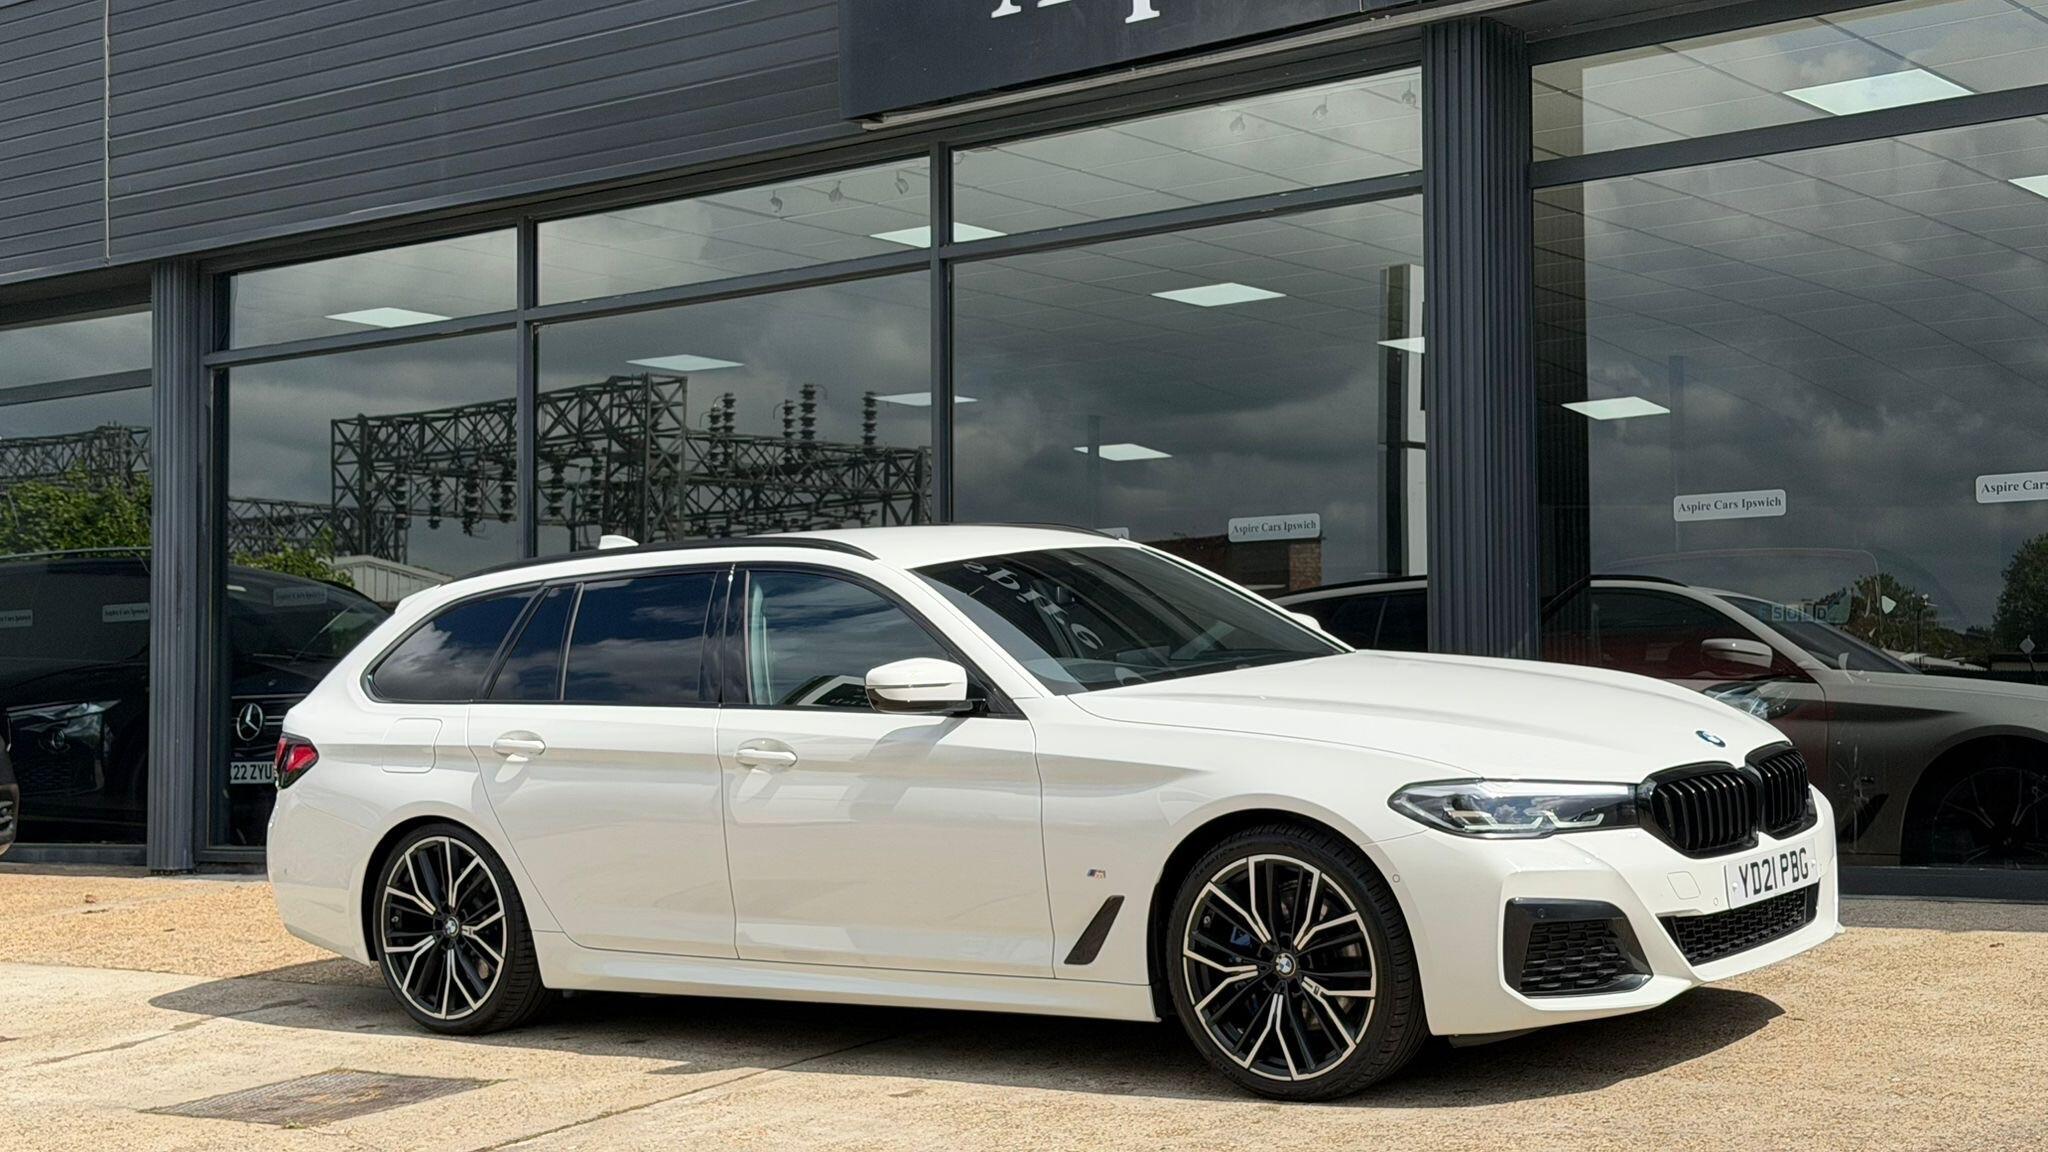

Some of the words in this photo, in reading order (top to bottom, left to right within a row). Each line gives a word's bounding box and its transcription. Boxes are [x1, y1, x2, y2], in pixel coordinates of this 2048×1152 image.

[1981, 481, 2020, 495] Aspire
[1679, 501, 1711, 514] Aspire
[1714, 500, 1738, 511] Cars
[1742, 497, 1782, 511] Ipswich
[1233, 523, 1259, 536] Aspire
[1261, 522, 1281, 533] Cars
[1283, 520, 1317, 533] Ipswich
[249, 764, 273, 780] ZYU
[1738, 856, 1778, 898] YD21
[1780, 847, 1809, 887] PBG
